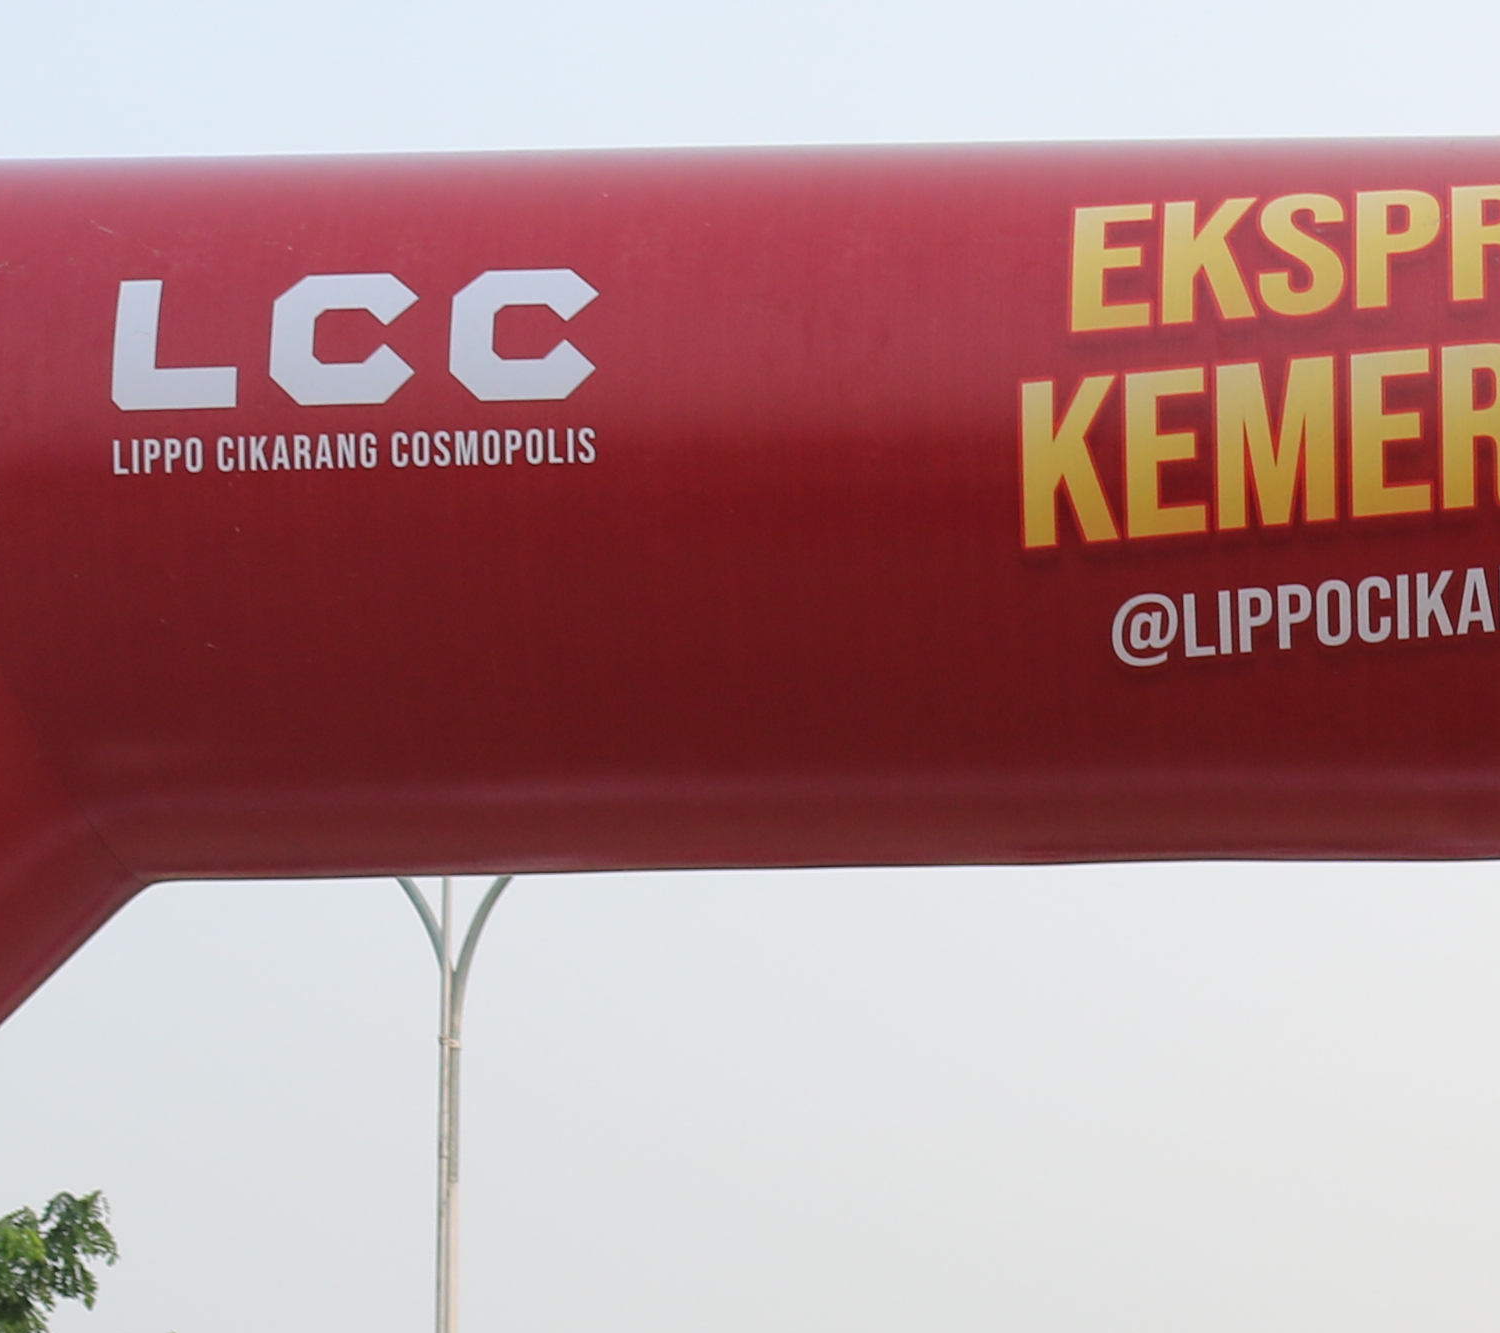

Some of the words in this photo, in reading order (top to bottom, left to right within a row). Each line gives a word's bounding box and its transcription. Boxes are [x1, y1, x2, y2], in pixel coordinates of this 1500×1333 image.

[111, 267, 600, 411] LCC
[112, 437, 203, 476] LIPPO
[216, 431, 378, 473] CIKARANG
[390, 427, 597, 468] COSMOPOLIS
